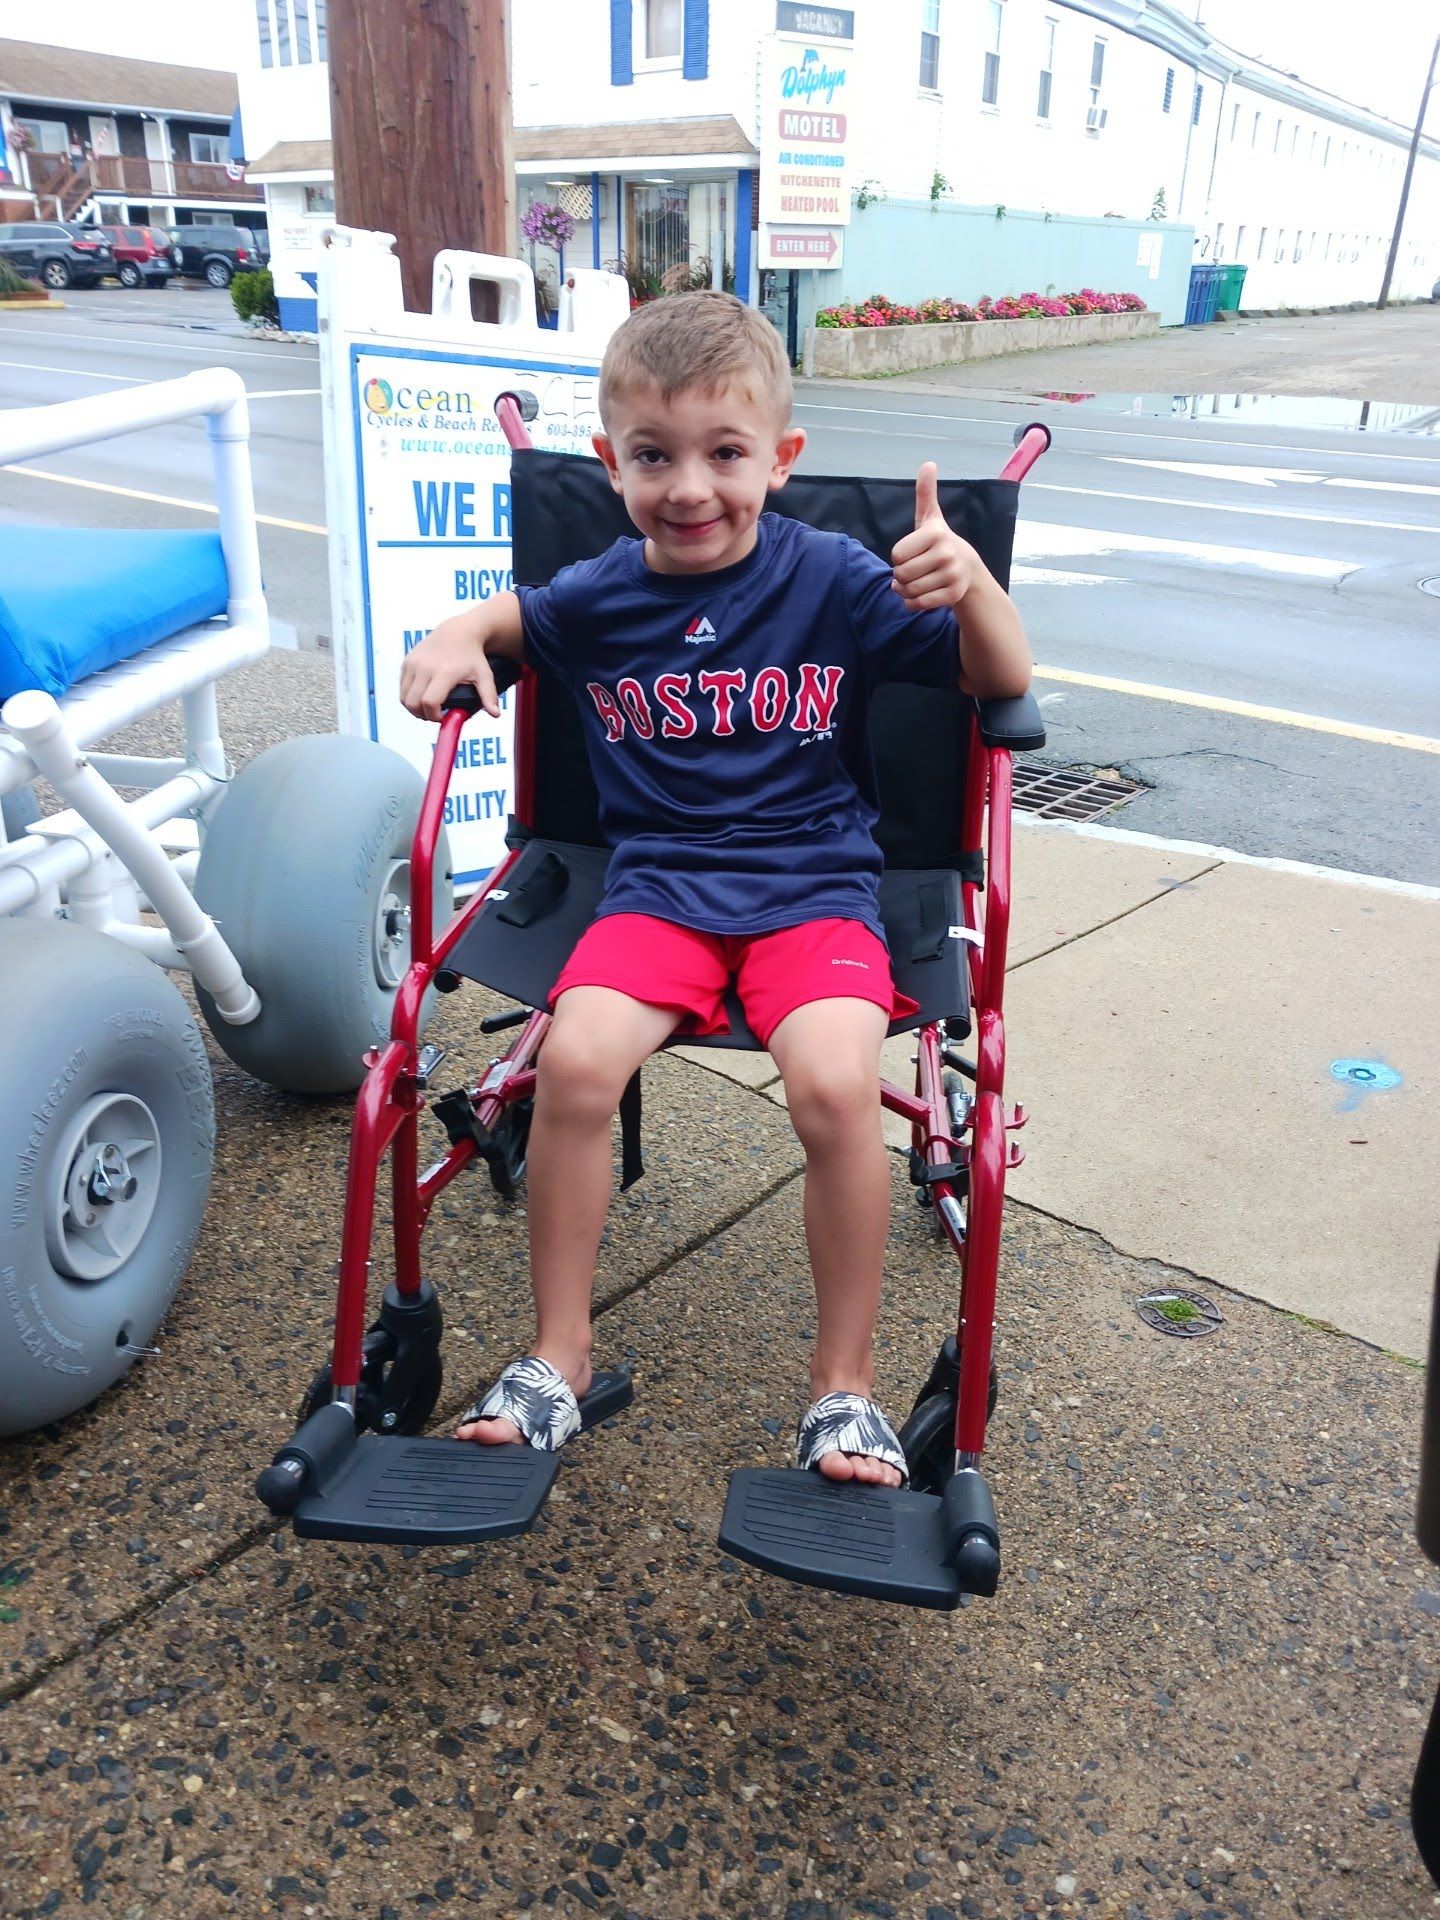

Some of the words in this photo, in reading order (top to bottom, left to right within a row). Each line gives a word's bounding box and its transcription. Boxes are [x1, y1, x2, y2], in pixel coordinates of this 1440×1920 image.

[784, 114, 841, 138] MOTEL
[779, 152, 792, 165] AIR
[794, 153, 845, 168] CONDITIONED
[781, 174, 842, 188] KITCHENETTE
[781, 196, 815, 213] HEATED
[816, 197, 840, 213] POOL
[776, 239, 805, 253] ENTER
[807, 240, 830, 253] HERE
[367, 411, 414, 430] Cycles
[418, 414, 429, 429] &
[434, 415, 477, 431] Beach
[412, 480, 476, 537] WE
[586, 663, 845, 743] BOSTON
[432, 736, 507, 769] HEEL
